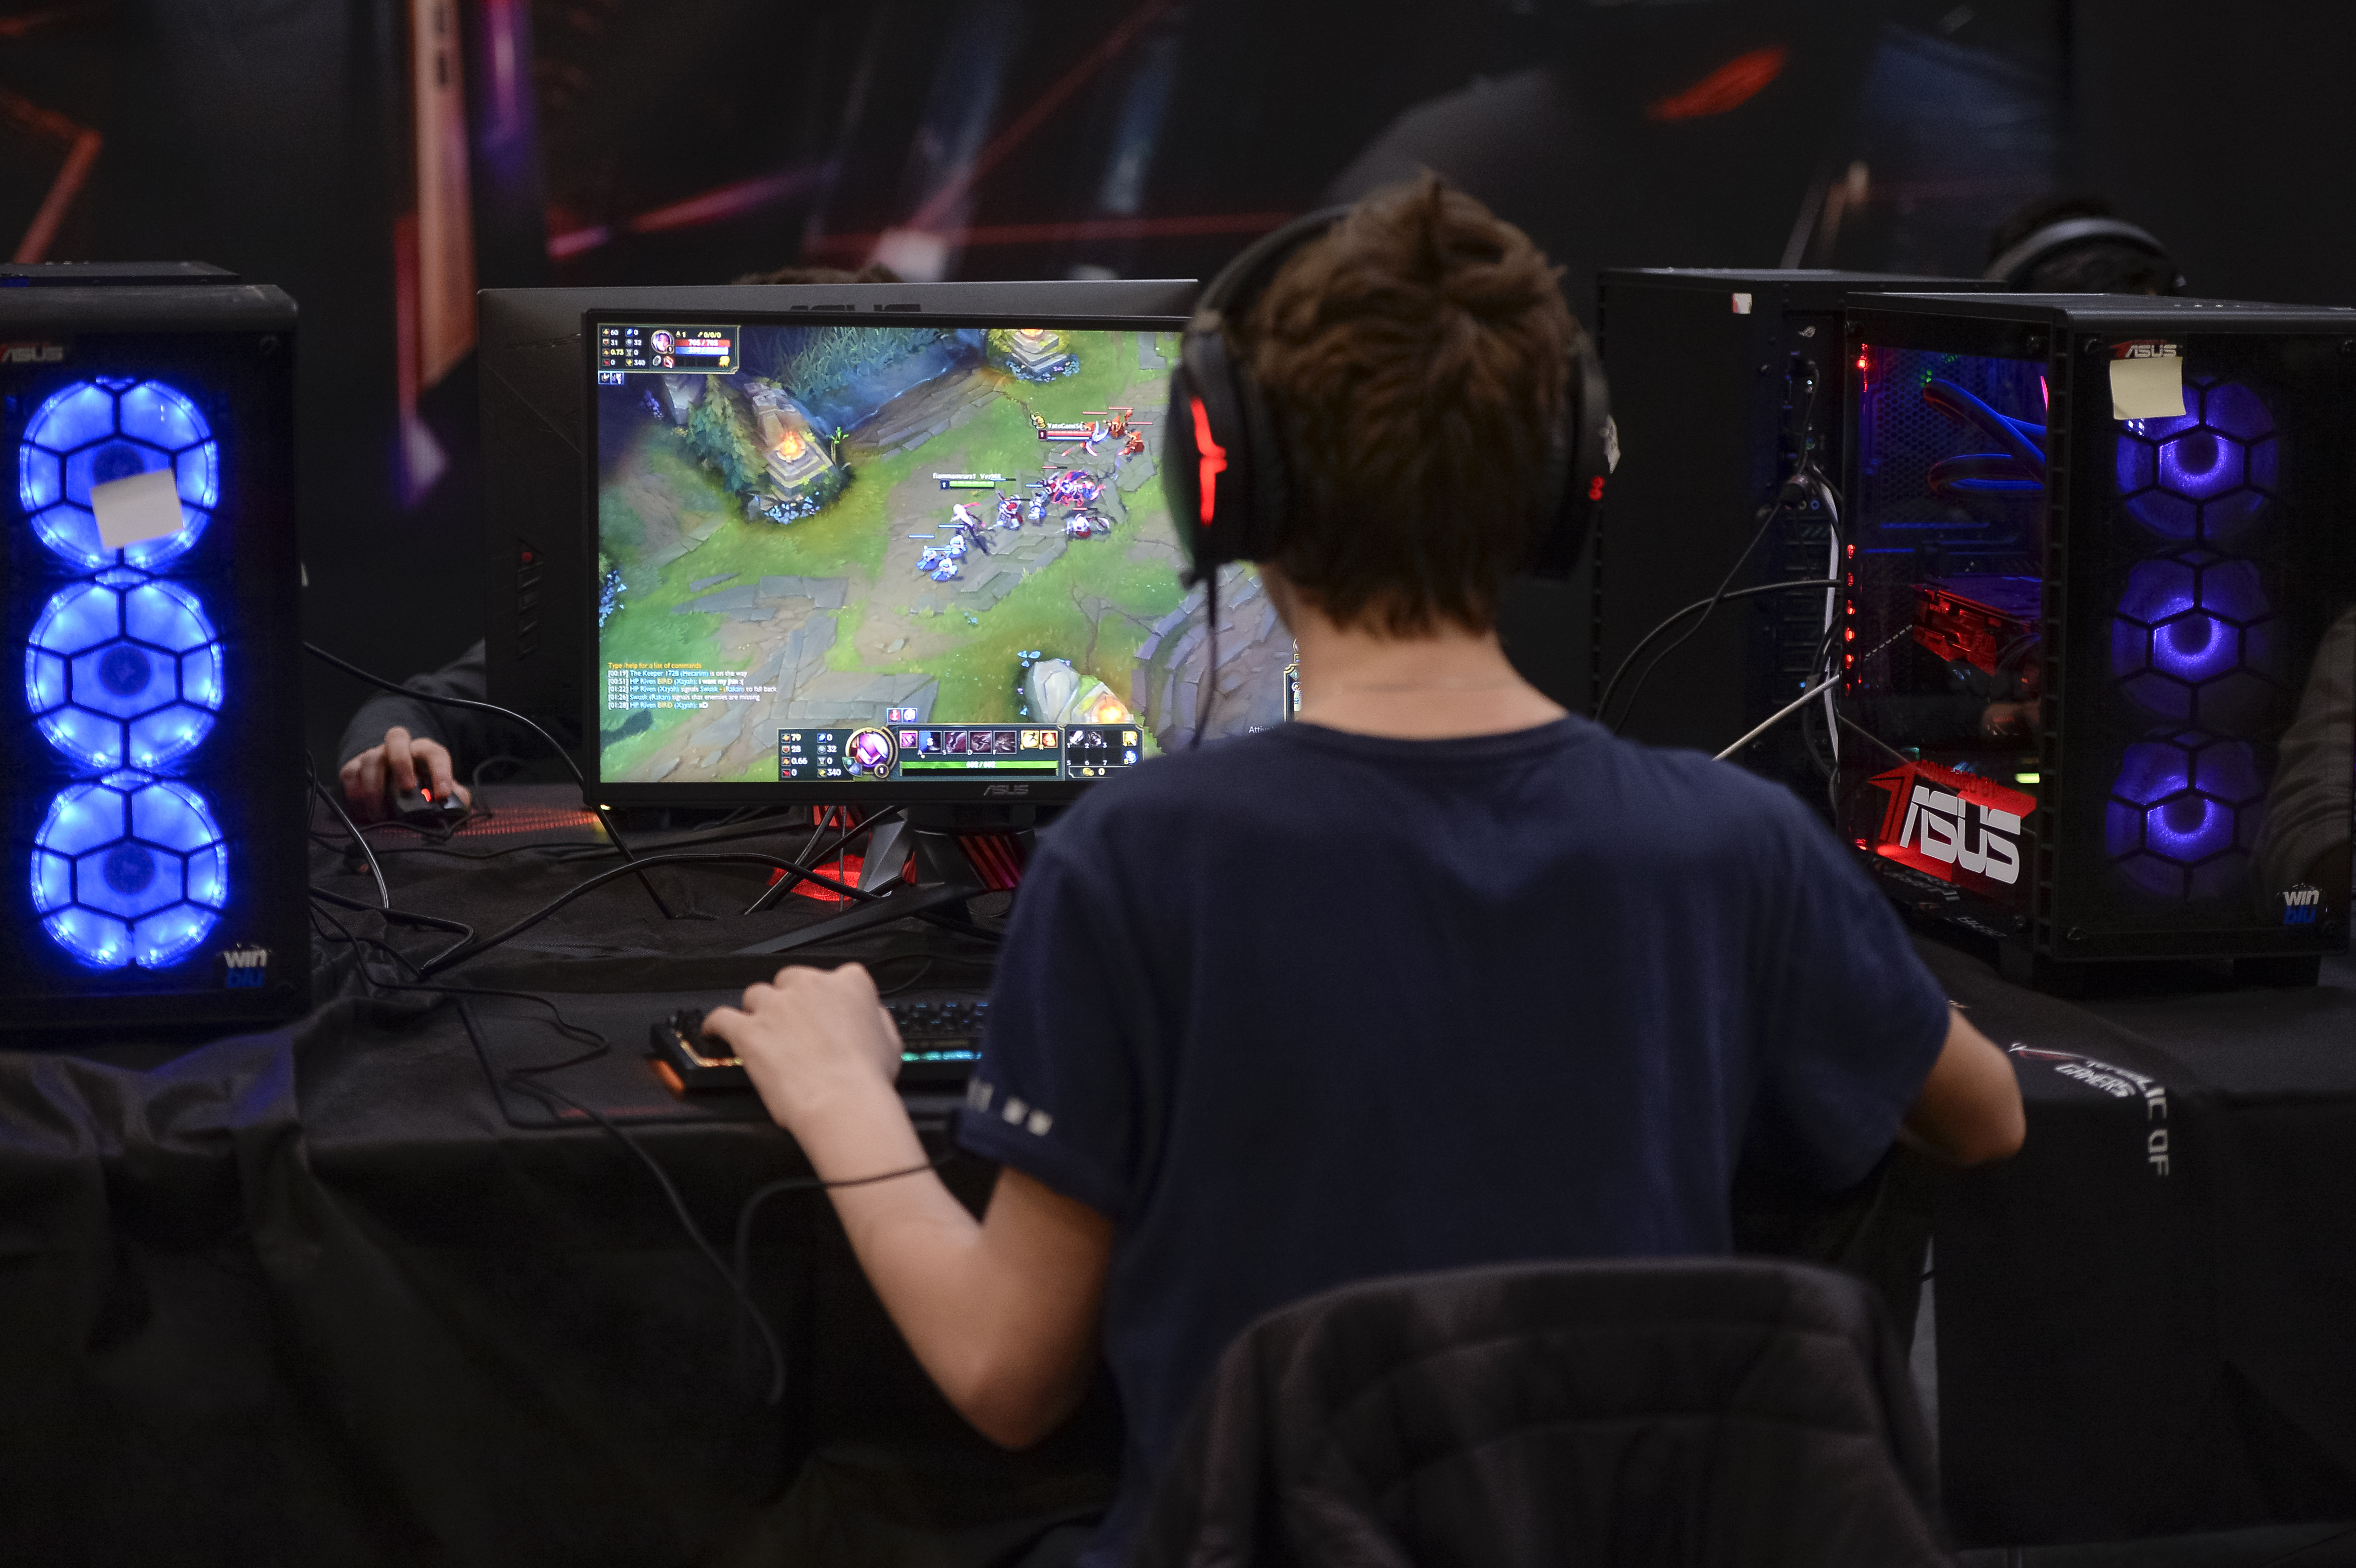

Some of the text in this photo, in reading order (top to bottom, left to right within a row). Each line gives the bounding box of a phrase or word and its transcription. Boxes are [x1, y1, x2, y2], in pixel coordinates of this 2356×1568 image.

[2, 347, 63, 362] ASUS
[2125, 345, 2178, 358] ASUS
[608, 670, 628, 678] [00:19]
[1098, 768, 1105, 776] 0
[983, 785, 1029, 796] ASUS
[1899, 785, 2021, 884] ASUS
[2283, 890, 2319, 906] win
[224, 949, 268, 968] win
